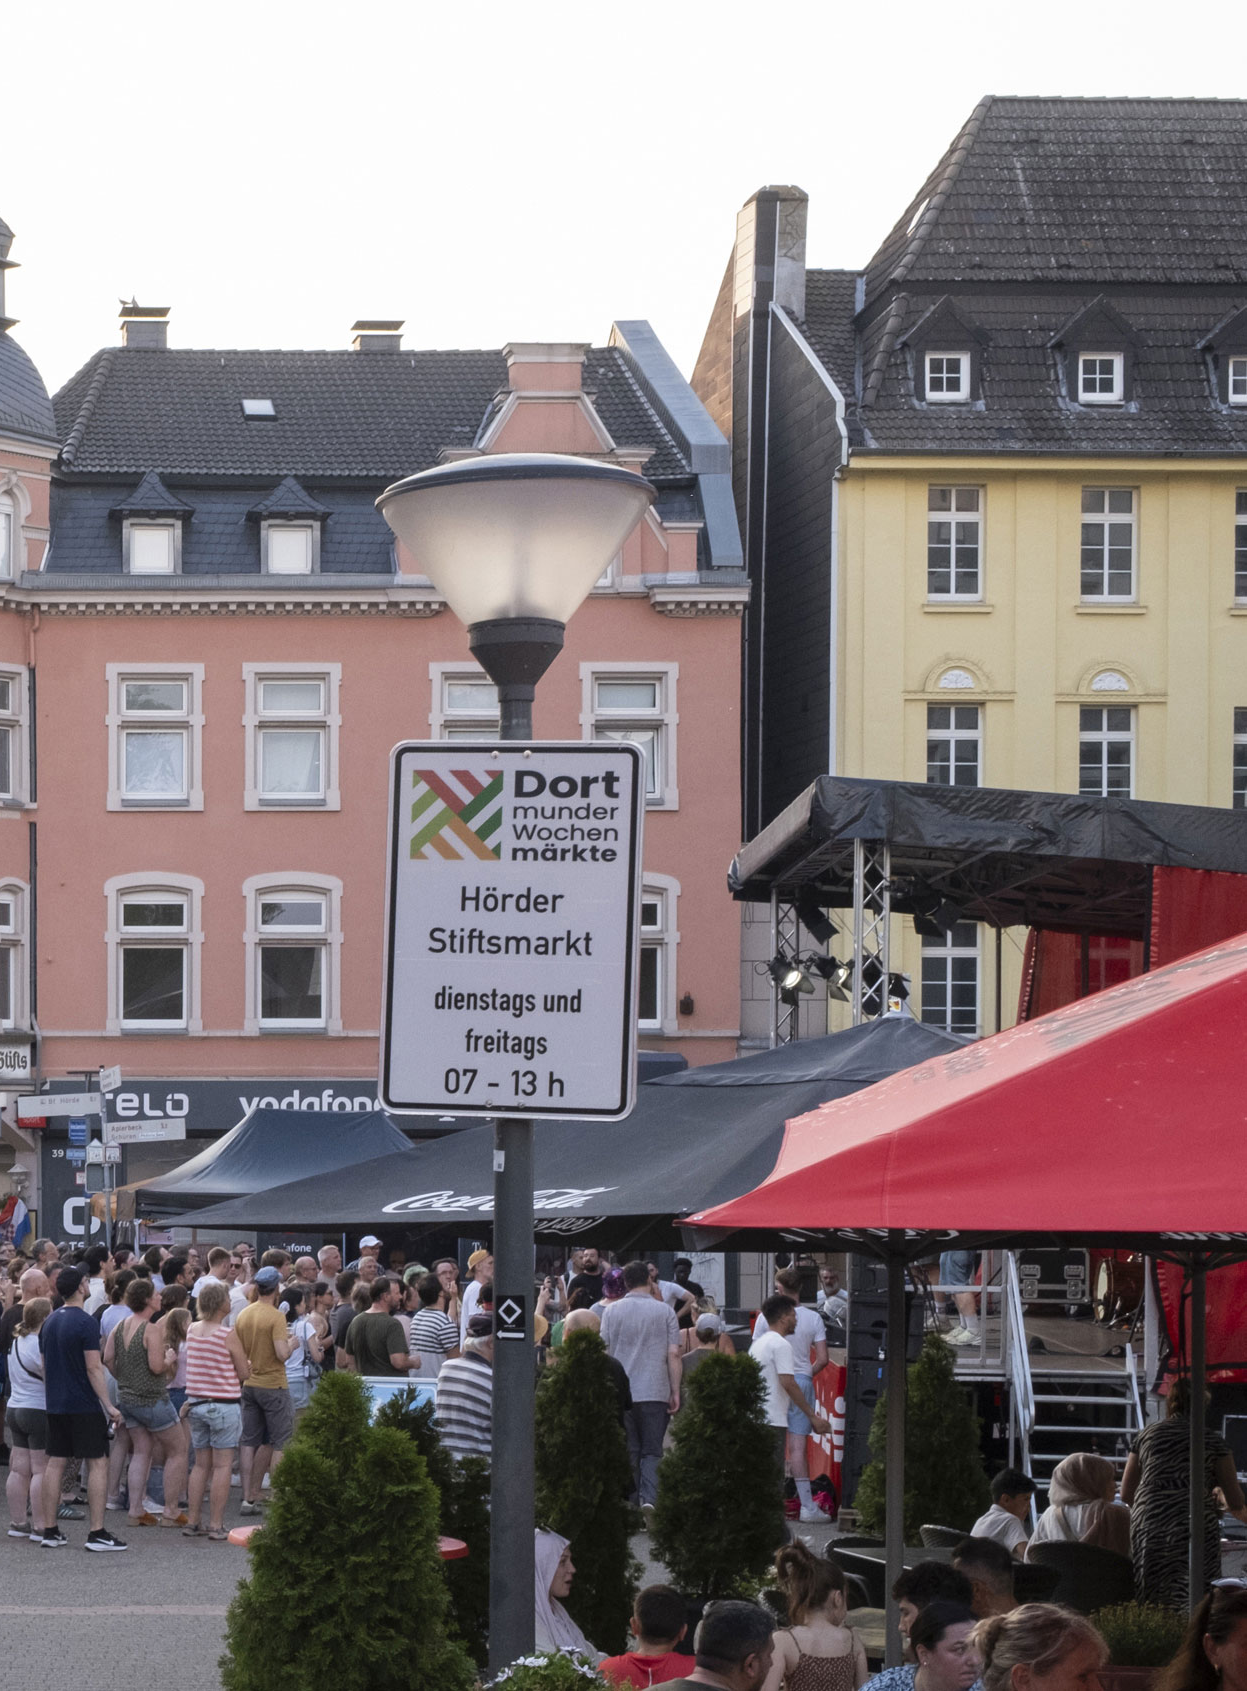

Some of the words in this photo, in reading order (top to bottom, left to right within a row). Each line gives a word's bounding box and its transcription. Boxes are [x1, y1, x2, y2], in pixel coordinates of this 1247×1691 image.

[514, 770, 619, 798] Dort
[513, 803, 618, 821] munder
[513, 824, 618, 842] Wochen
[512, 844, 617, 862] märkte
[460, 886, 564, 914] Hörder
[428, 927, 592, 956] Stiftsmarkt
[434, 986, 536, 1018] dienstags
[543, 989, 582, 1013] und
[465, 1029, 548, 1060] freitags
[444, 1068, 478, 1095] 07
[511, 1070, 537, 1096] 13
[548, 1071, 565, 1097] h
[51, 1149, 64, 1158] 39
